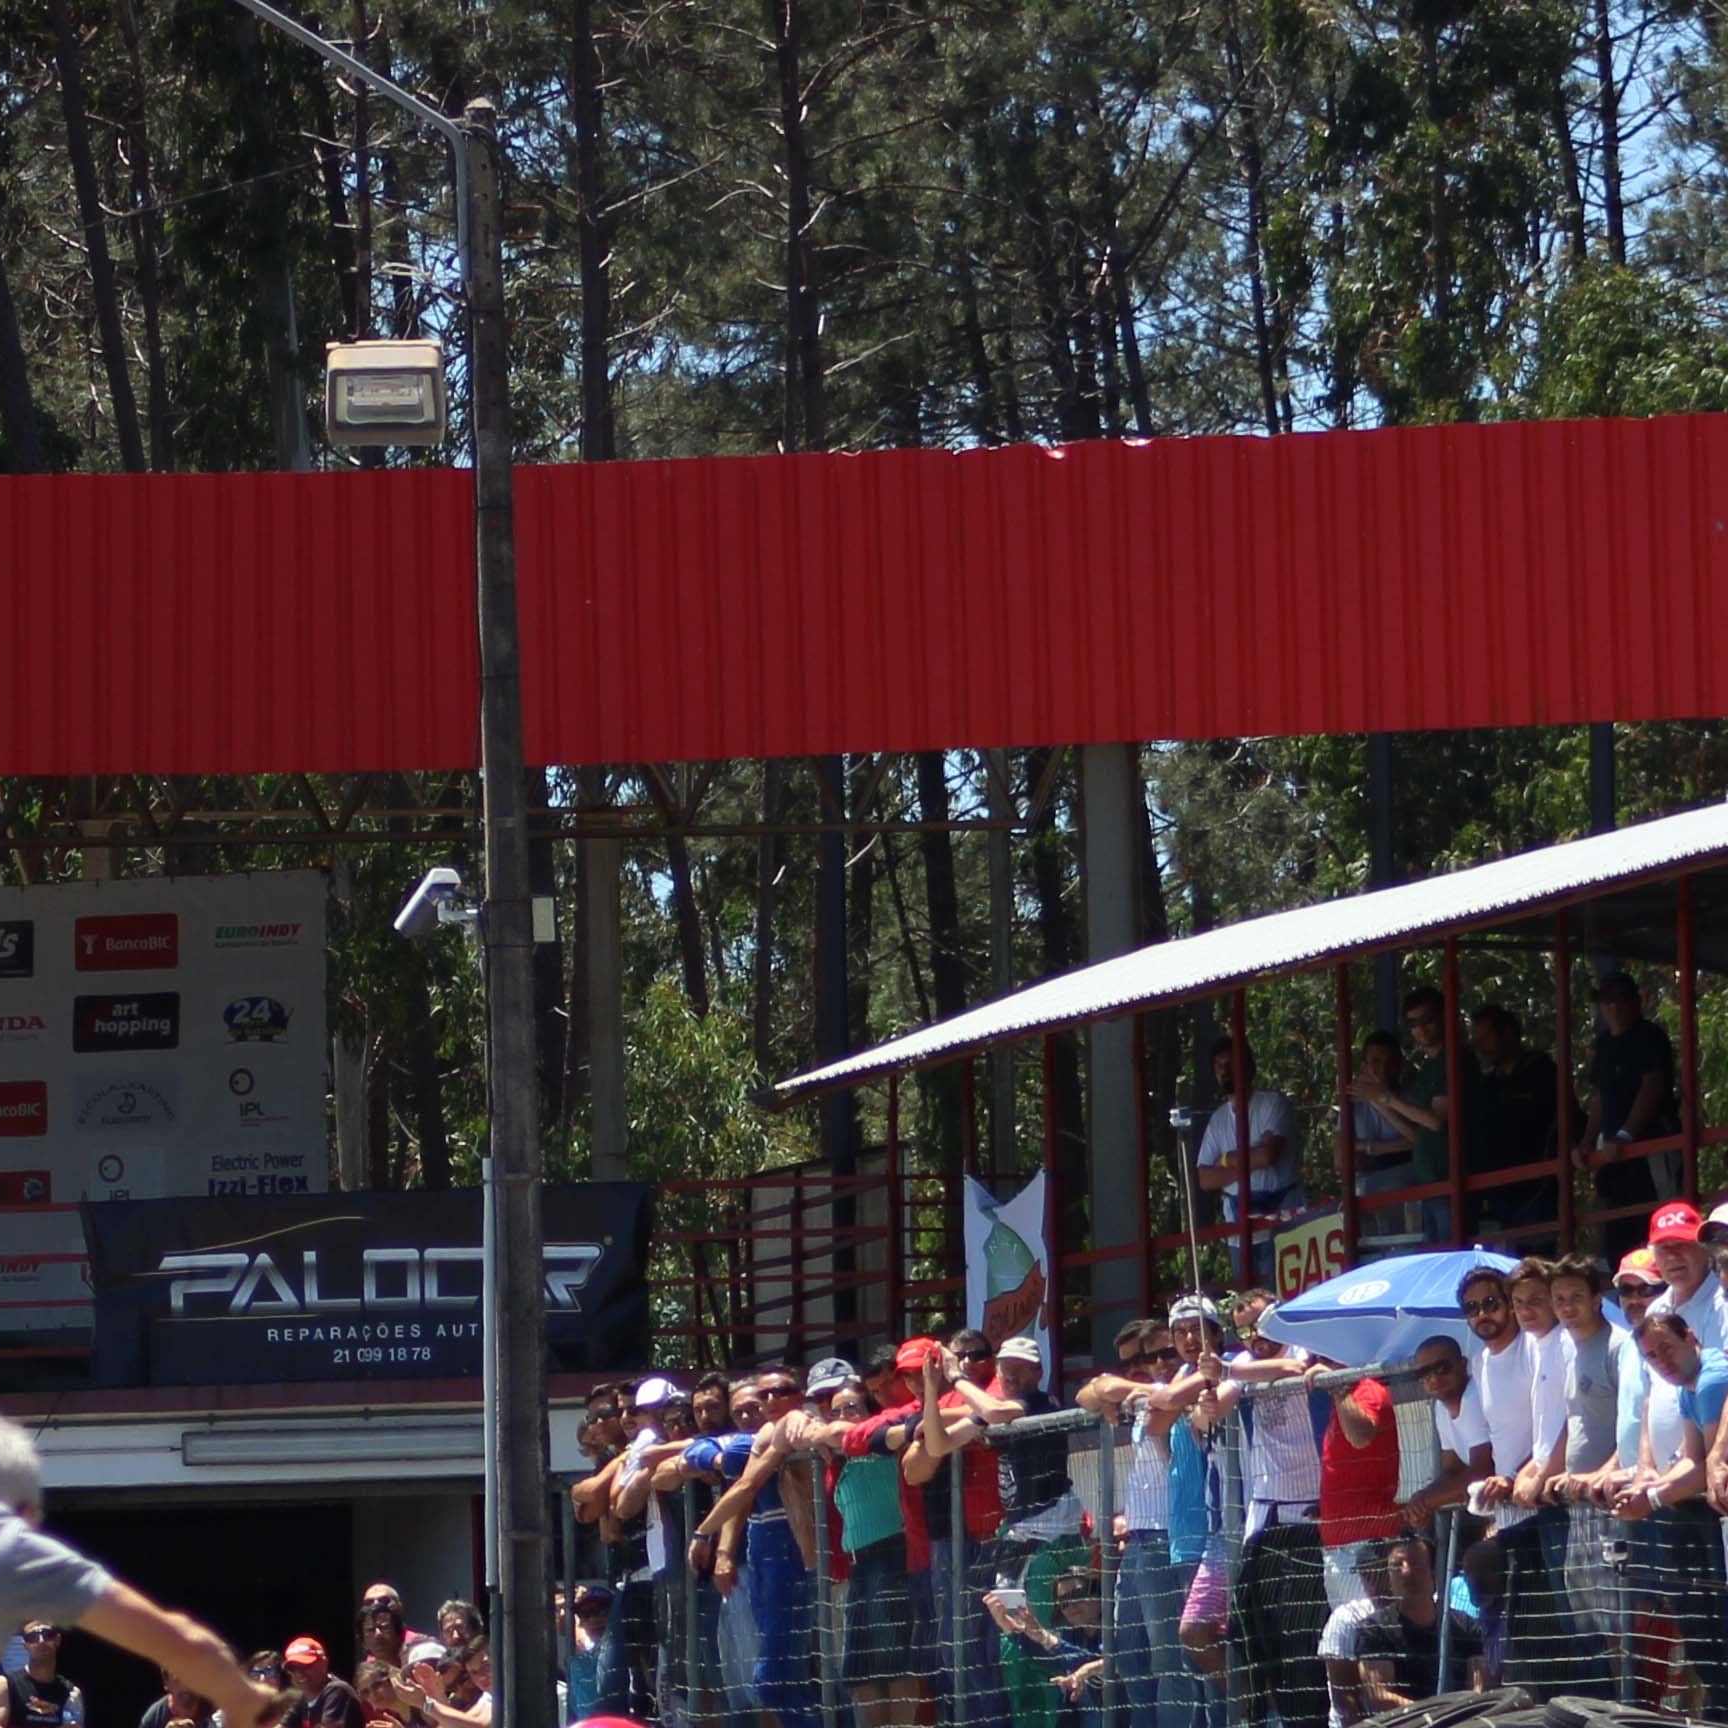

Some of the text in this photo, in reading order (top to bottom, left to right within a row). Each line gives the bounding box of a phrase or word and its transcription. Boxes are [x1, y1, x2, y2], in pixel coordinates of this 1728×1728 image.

[215, 923, 302, 938] EUROINDY
[105, 935, 171, 952] BancoBIC
[112, 1002, 139, 1017] art
[232, 999, 272, 1024] 24
[94, 1017, 171, 1038] hopping
[240, 1102, 264, 1116] IPL
[211, 1153, 304, 1172] Electric Power
[267, 1321, 480, 1342] REPARAÇÕES AUT
[333, 1348, 350, 1363] 21
[388, 1347, 408, 1362] 18
[411, 1346, 432, 1361] 78
